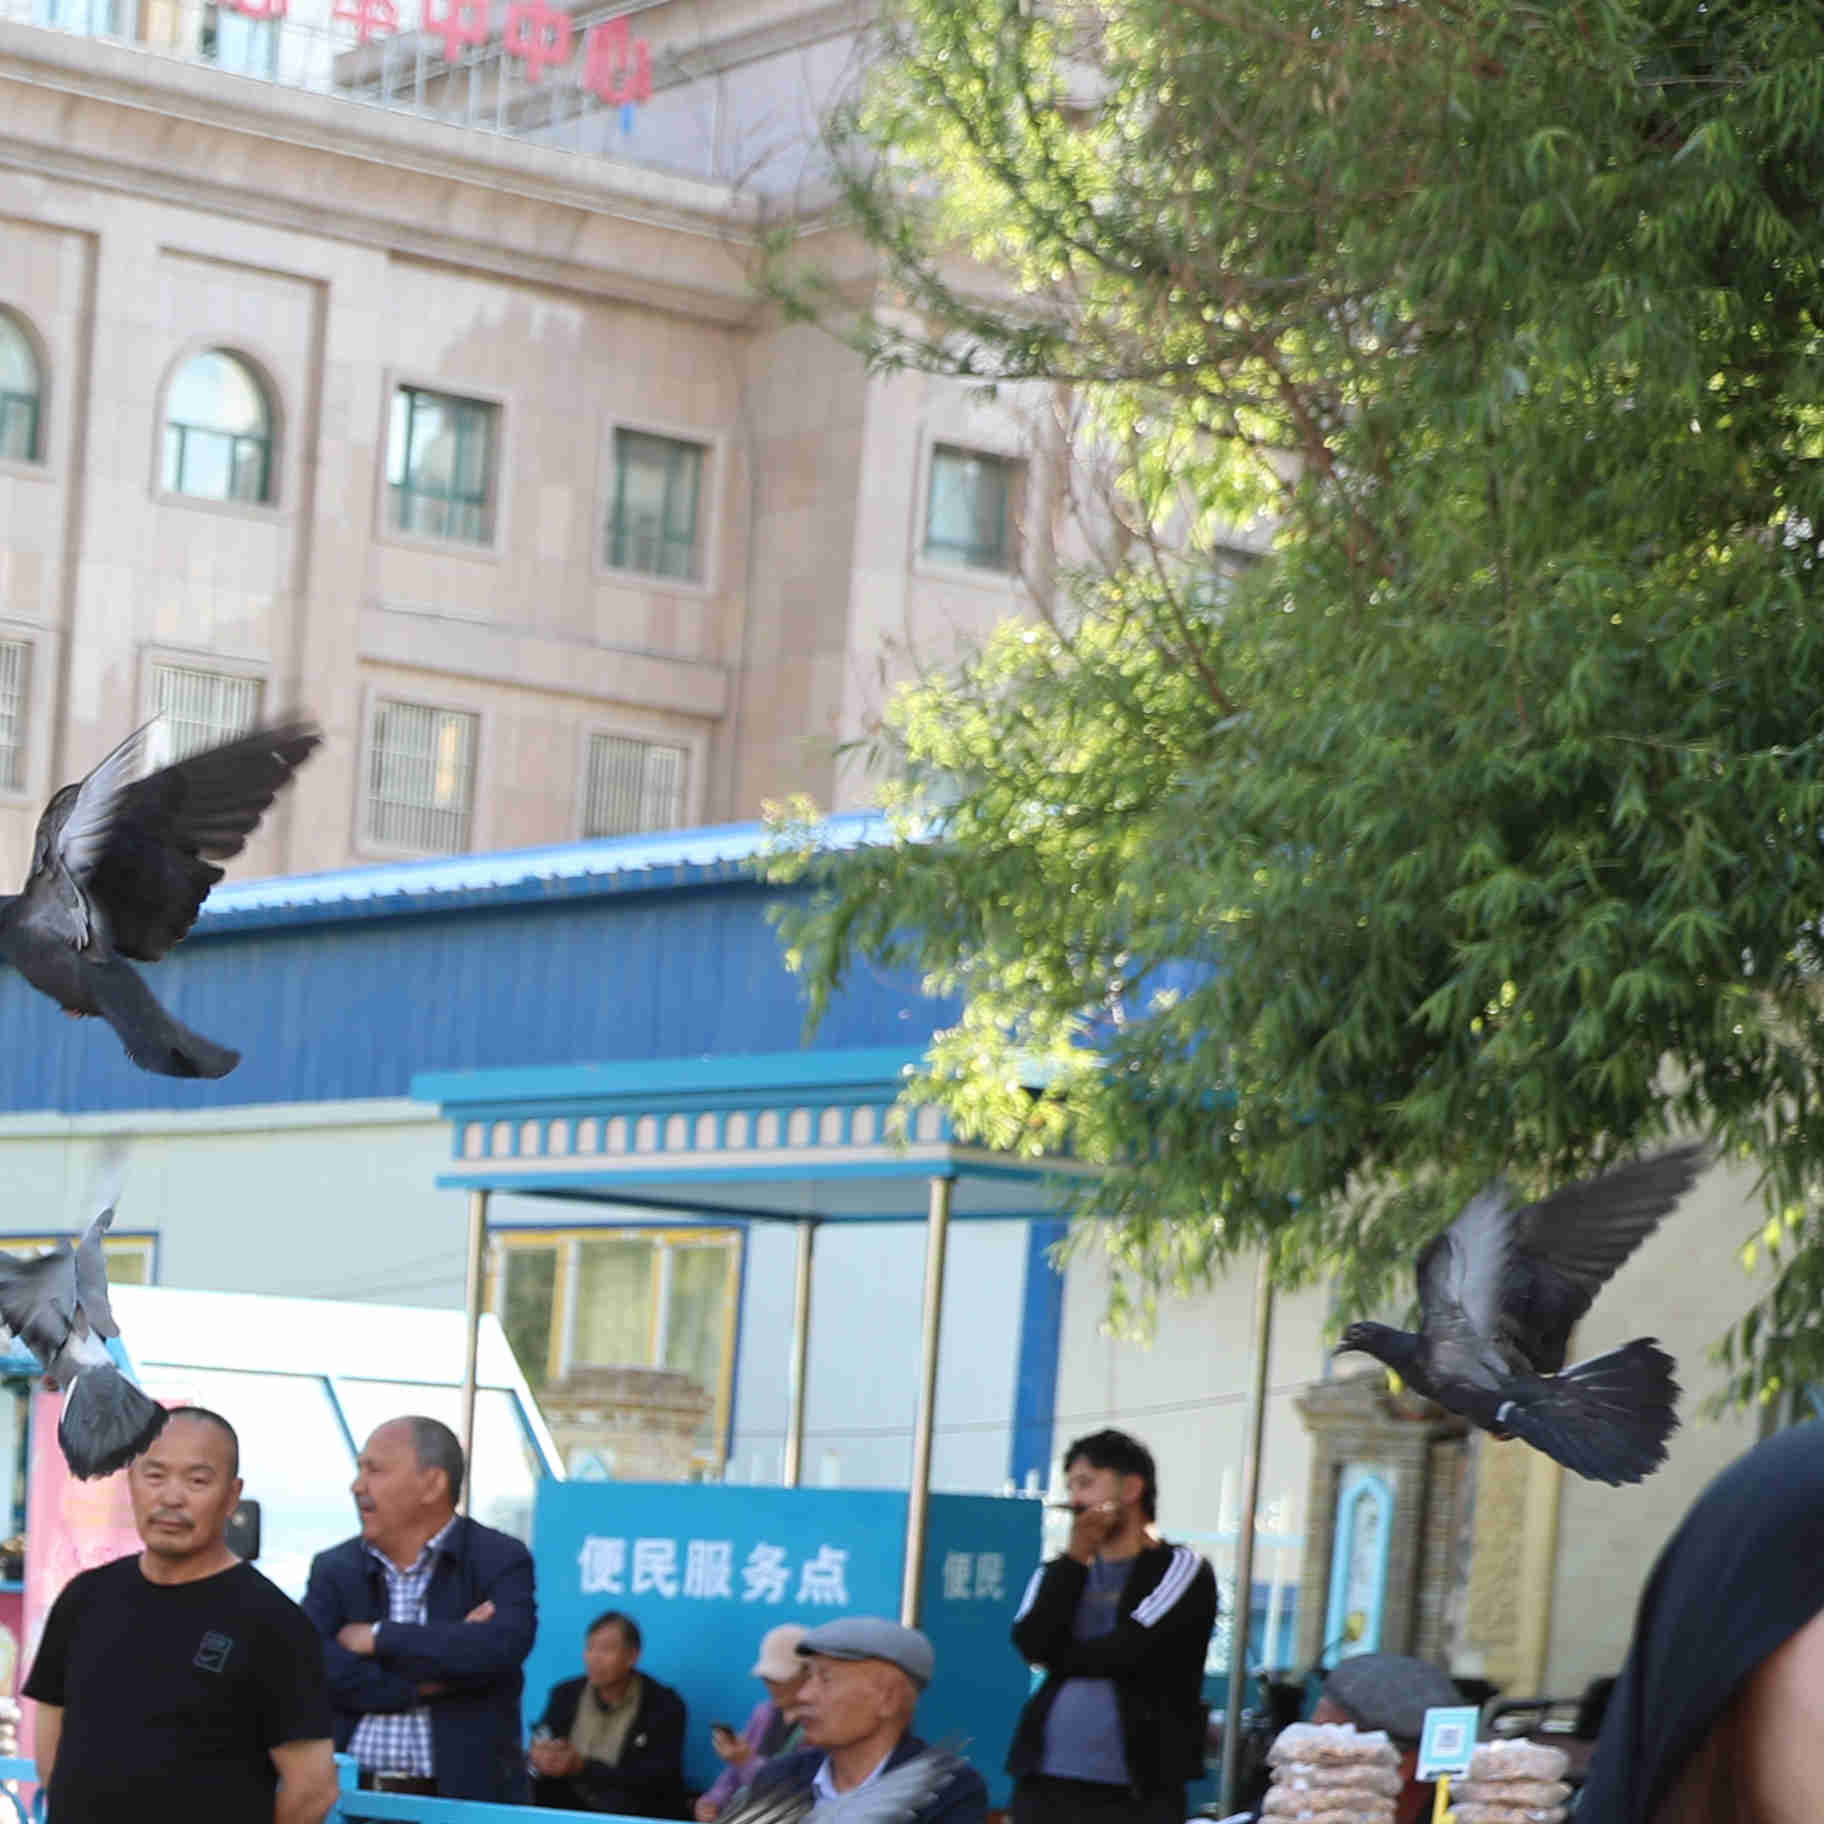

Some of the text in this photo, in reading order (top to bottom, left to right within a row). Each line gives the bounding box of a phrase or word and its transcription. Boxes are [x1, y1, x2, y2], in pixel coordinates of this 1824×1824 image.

[577, 1535, 850, 1607] 便民服务点
